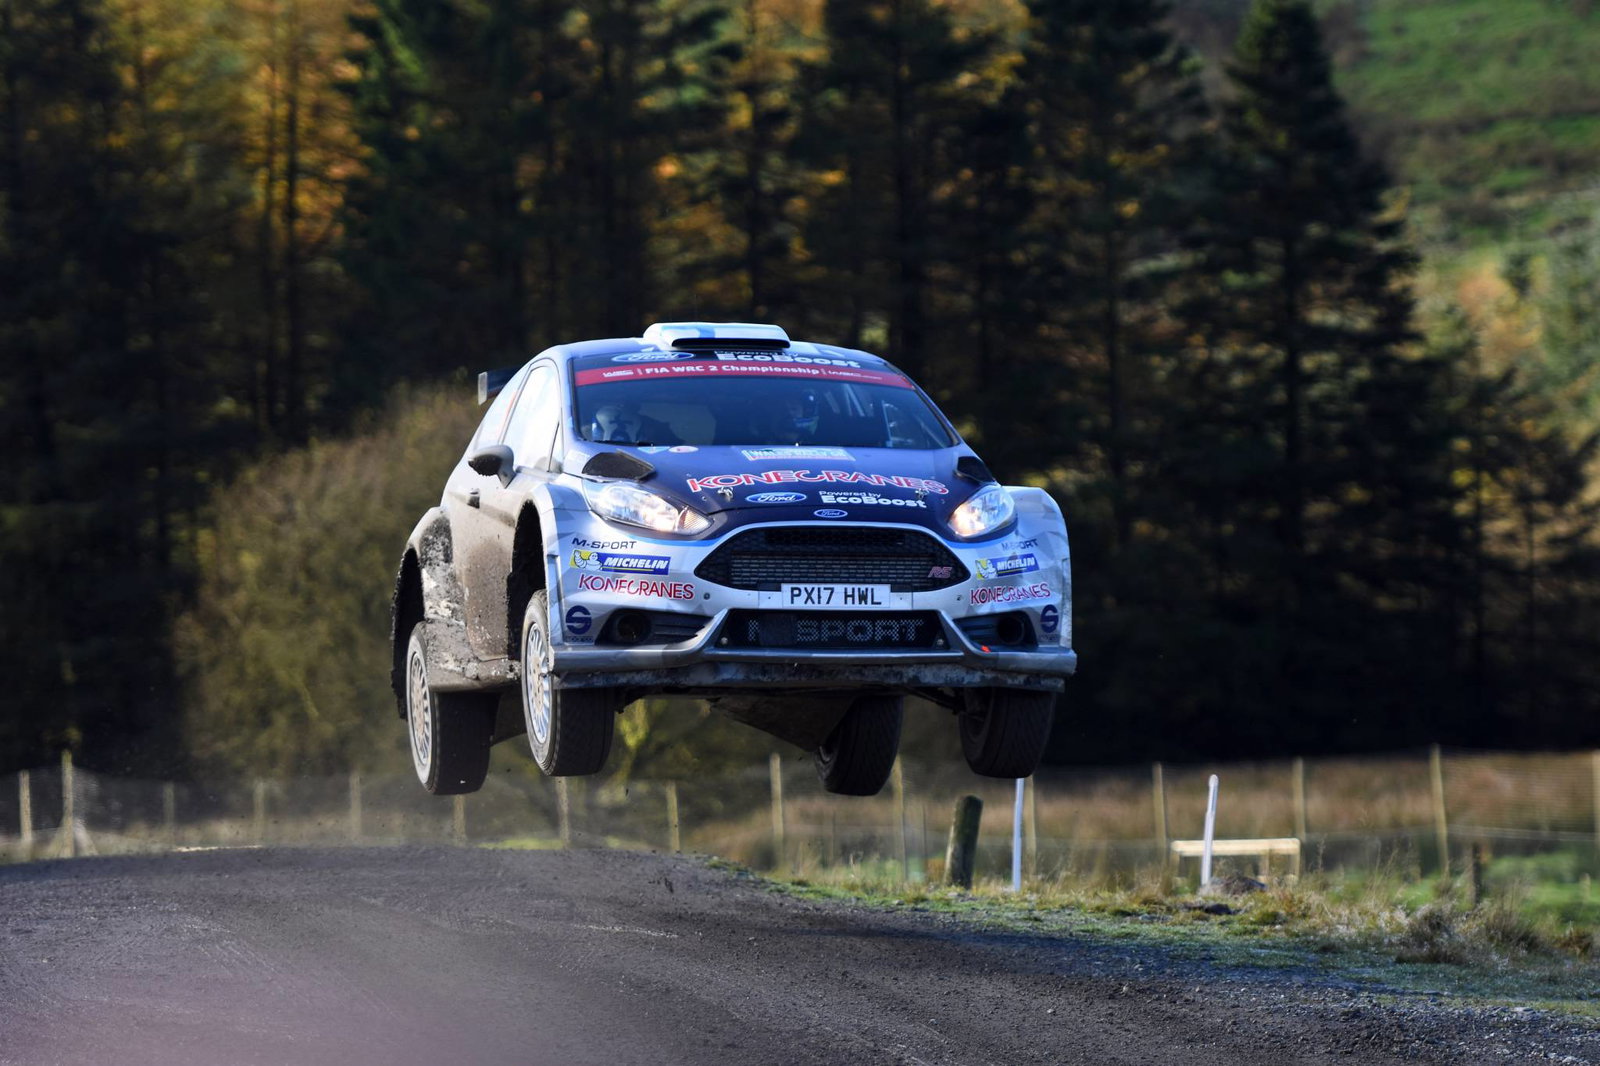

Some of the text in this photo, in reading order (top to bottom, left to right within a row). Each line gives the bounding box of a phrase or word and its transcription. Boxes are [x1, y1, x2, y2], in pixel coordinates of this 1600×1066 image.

[716, 353, 861, 369] EcoBoost
[672, 365, 705, 373] WRC
[721, 365, 820, 375] Championship
[687, 469, 950, 494] KONECRANES
[868, 491, 881, 499] by
[821, 495, 927, 509] EcoBoost
[572, 537, 637, 550] M-SPORT
[604, 556, 669, 569] MICHELIN
[997, 557, 1036, 570] MICHELIN
[928, 566, 953, 579] RS
[578, 574, 696, 600] KONECRANES
[970, 582, 1051, 605] KONECRANES
[789, 586, 882, 605] PX17 HWL
